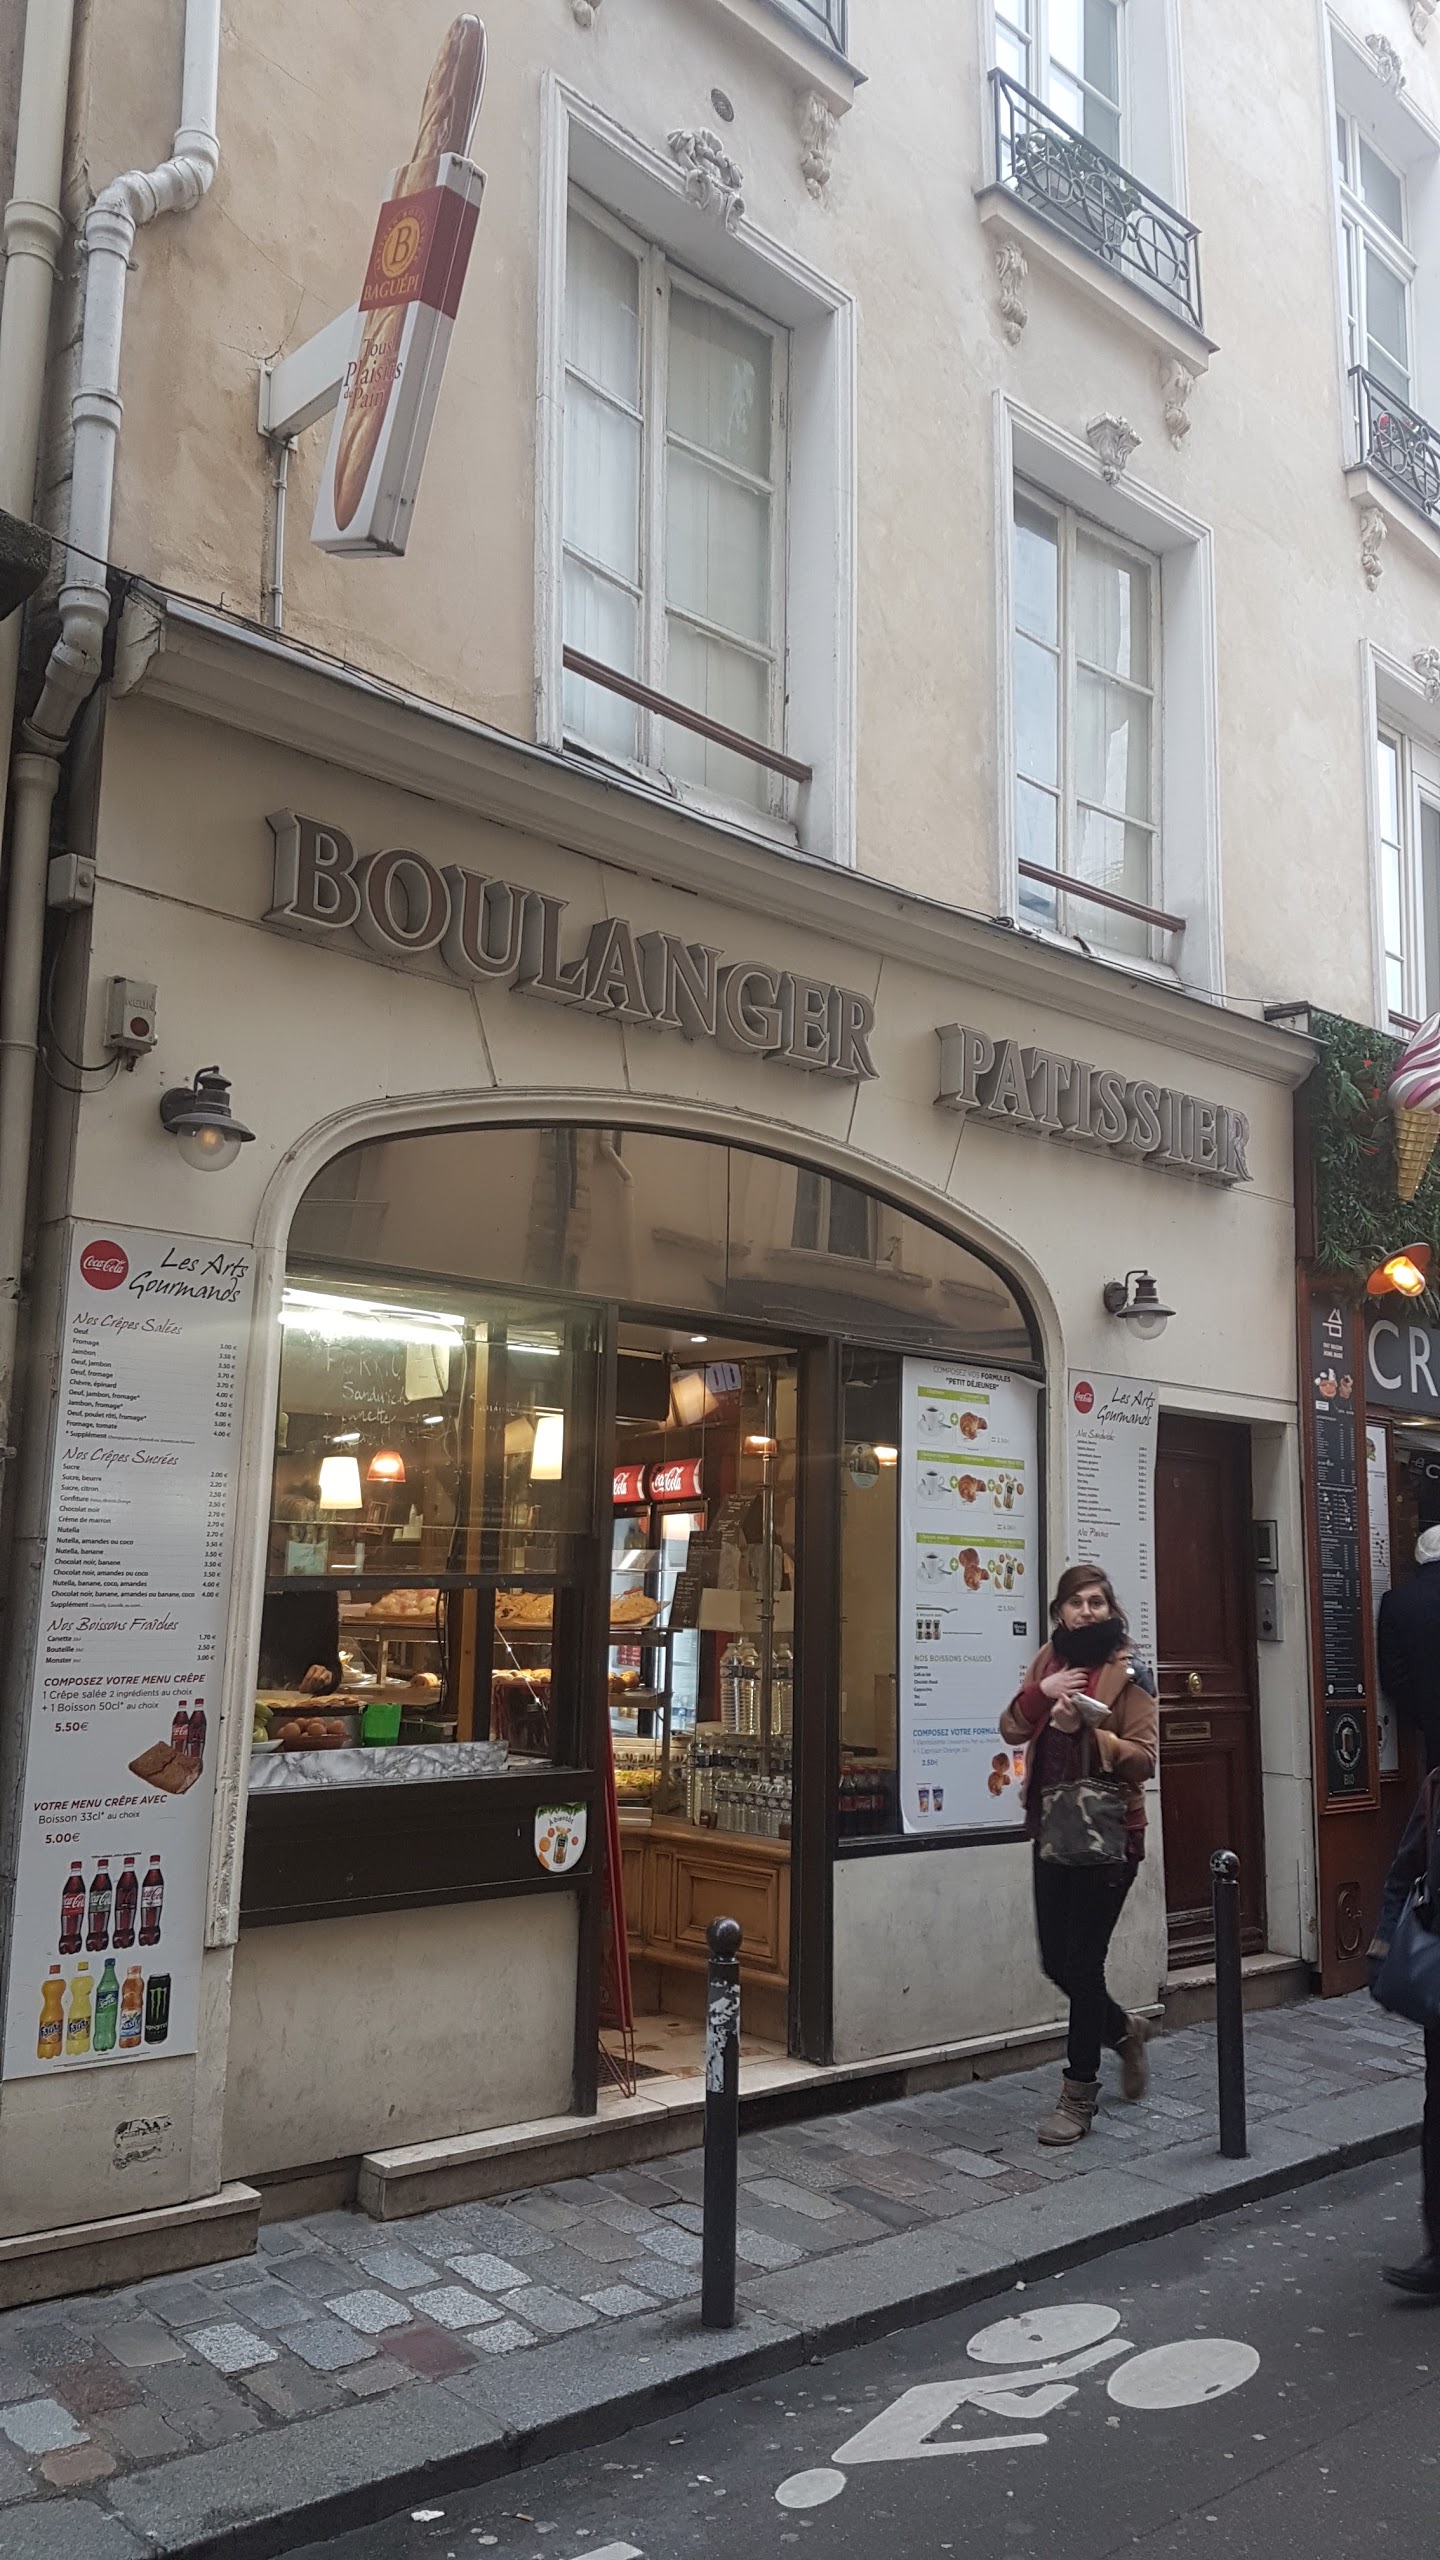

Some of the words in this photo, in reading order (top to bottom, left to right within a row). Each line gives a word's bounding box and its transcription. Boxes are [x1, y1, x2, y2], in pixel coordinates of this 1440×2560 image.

[364, 273, 419, 300] BAGUÉPI
[363, 338, 393, 357] Tous
[262, 807, 880, 1084] BOULANGER
[933, 1022, 1254, 1182] PATISSIER
[83, 1255, 126, 1274] Coca-Cola
[160, 1247, 199, 1272] Les
[200, 1253, 249, 1278] Arts
[128, 1271, 241, 1303] Gourmands
[72, 1312, 99, 1325] Nos
[100, 1314, 139, 1335] Crêpes
[141, 1318, 183, 1335] Salées
[72, 1337, 99, 1347] Fromage
[933, 1366, 966, 1377] COMPOSEZ
[967, 1371, 980, 1379] VOS
[981, 1373, 1011, 1382] FORMULES
[1111, 1386, 1130, 1404] Les
[1131, 1390, 1156, 1408] Arts
[1097, 1404, 1151, 1426] Gourmands
[62, 1446, 89, 1460] Nos
[90, 1448, 130, 1469] Crêpes
[131, 1450, 179, 1465] Sucrées
[56, 1537, 81, 1545] Nutella,
[50, 1601, 89, 1609] Supplément
[47, 1617, 74, 1632] Nos
[76, 1617, 127, 1631] Boissons
[129, 1612, 179, 1631] Fraîches
[44, 1677, 103, 1687] COMPOSEZ
[106, 1676, 140, 1685] VOTRE
[141, 1675, 171, 1684] MENU
[173, 1672, 206, 1683] CRÊPE
[42, 1691, 46, 1699] 1
[50, 1690, 80, 1701] Crêpe
[82, 1689, 107, 1698] salée
[110, 1690, 114, 1698] 2
[116, 1688, 159, 1698] ingrédients
[172, 1688, 192, 1696] choix
[51, 1704, 54, 1712] 1
[57, 1702, 96, 1712] Boisson
[137, 1701, 159, 1709] choix
[55, 1721, 89, 1732] 5.50€
[913, 1729, 949, 1737] COMPOSEZ
[951, 1728, 971, 1736] VOTRE
[33, 1800, 68, 1811] VOTRE
[71, 1799, 101, 1809] MENU
[104, 1796, 138, 1807] CRÊPE
[139, 1795, 168, 1804] AVEC
[38, 1815, 77, 1825] Boisson
[118, 1811, 140, 1819] choix
[45, 1833, 80, 1843] 5.00€
